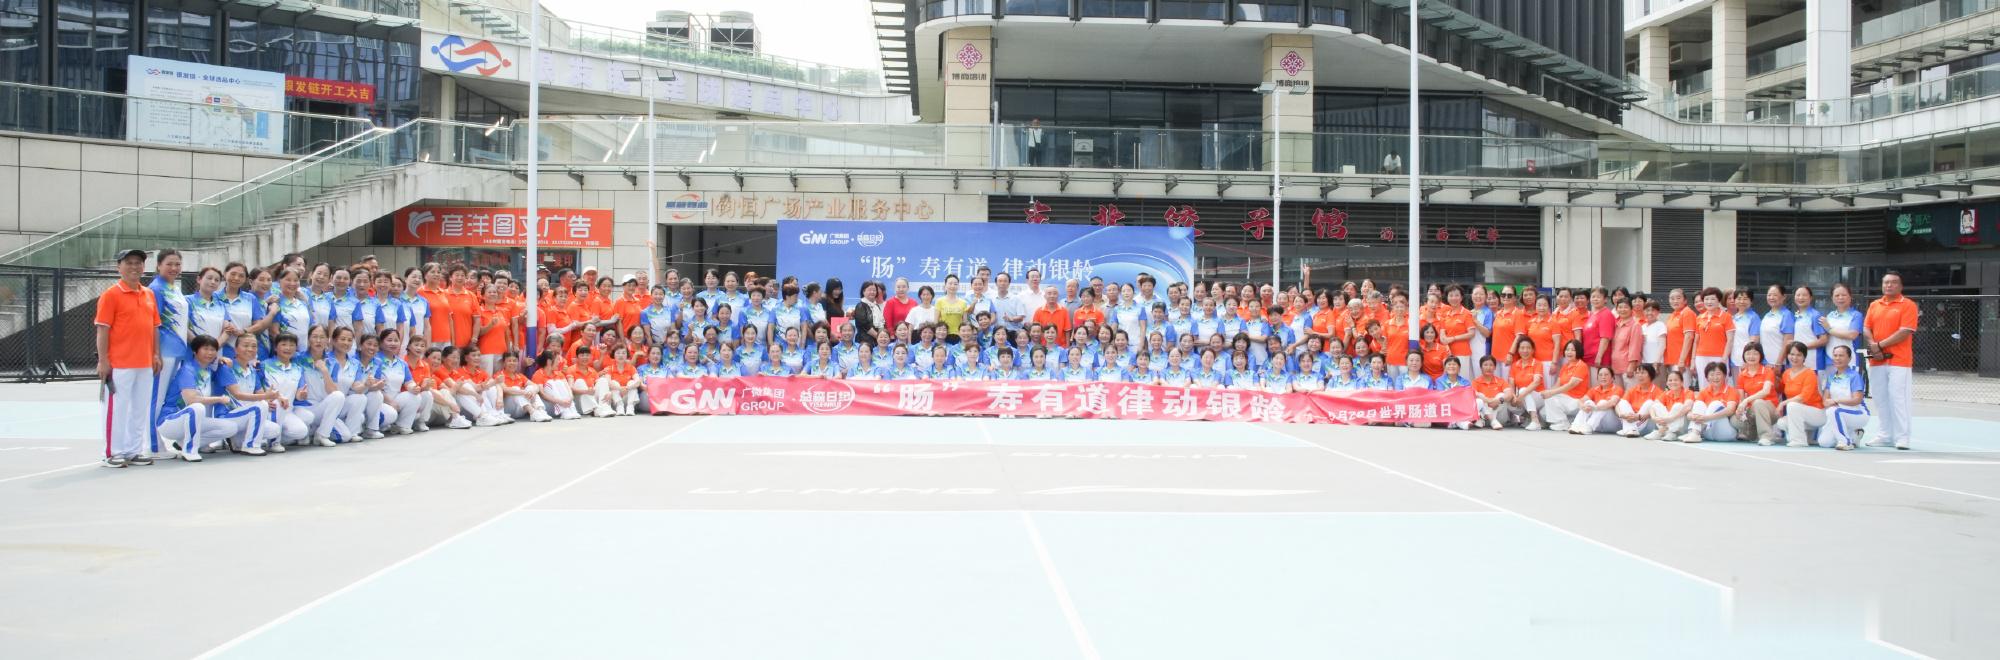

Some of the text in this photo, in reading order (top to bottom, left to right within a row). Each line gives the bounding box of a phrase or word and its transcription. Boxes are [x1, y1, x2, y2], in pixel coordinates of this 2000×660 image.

[441, 213, 591, 239] 彦洋图文广告
[741, 400, 785, 411] GROUP
[687, 487, 998, 495] LI-NING
